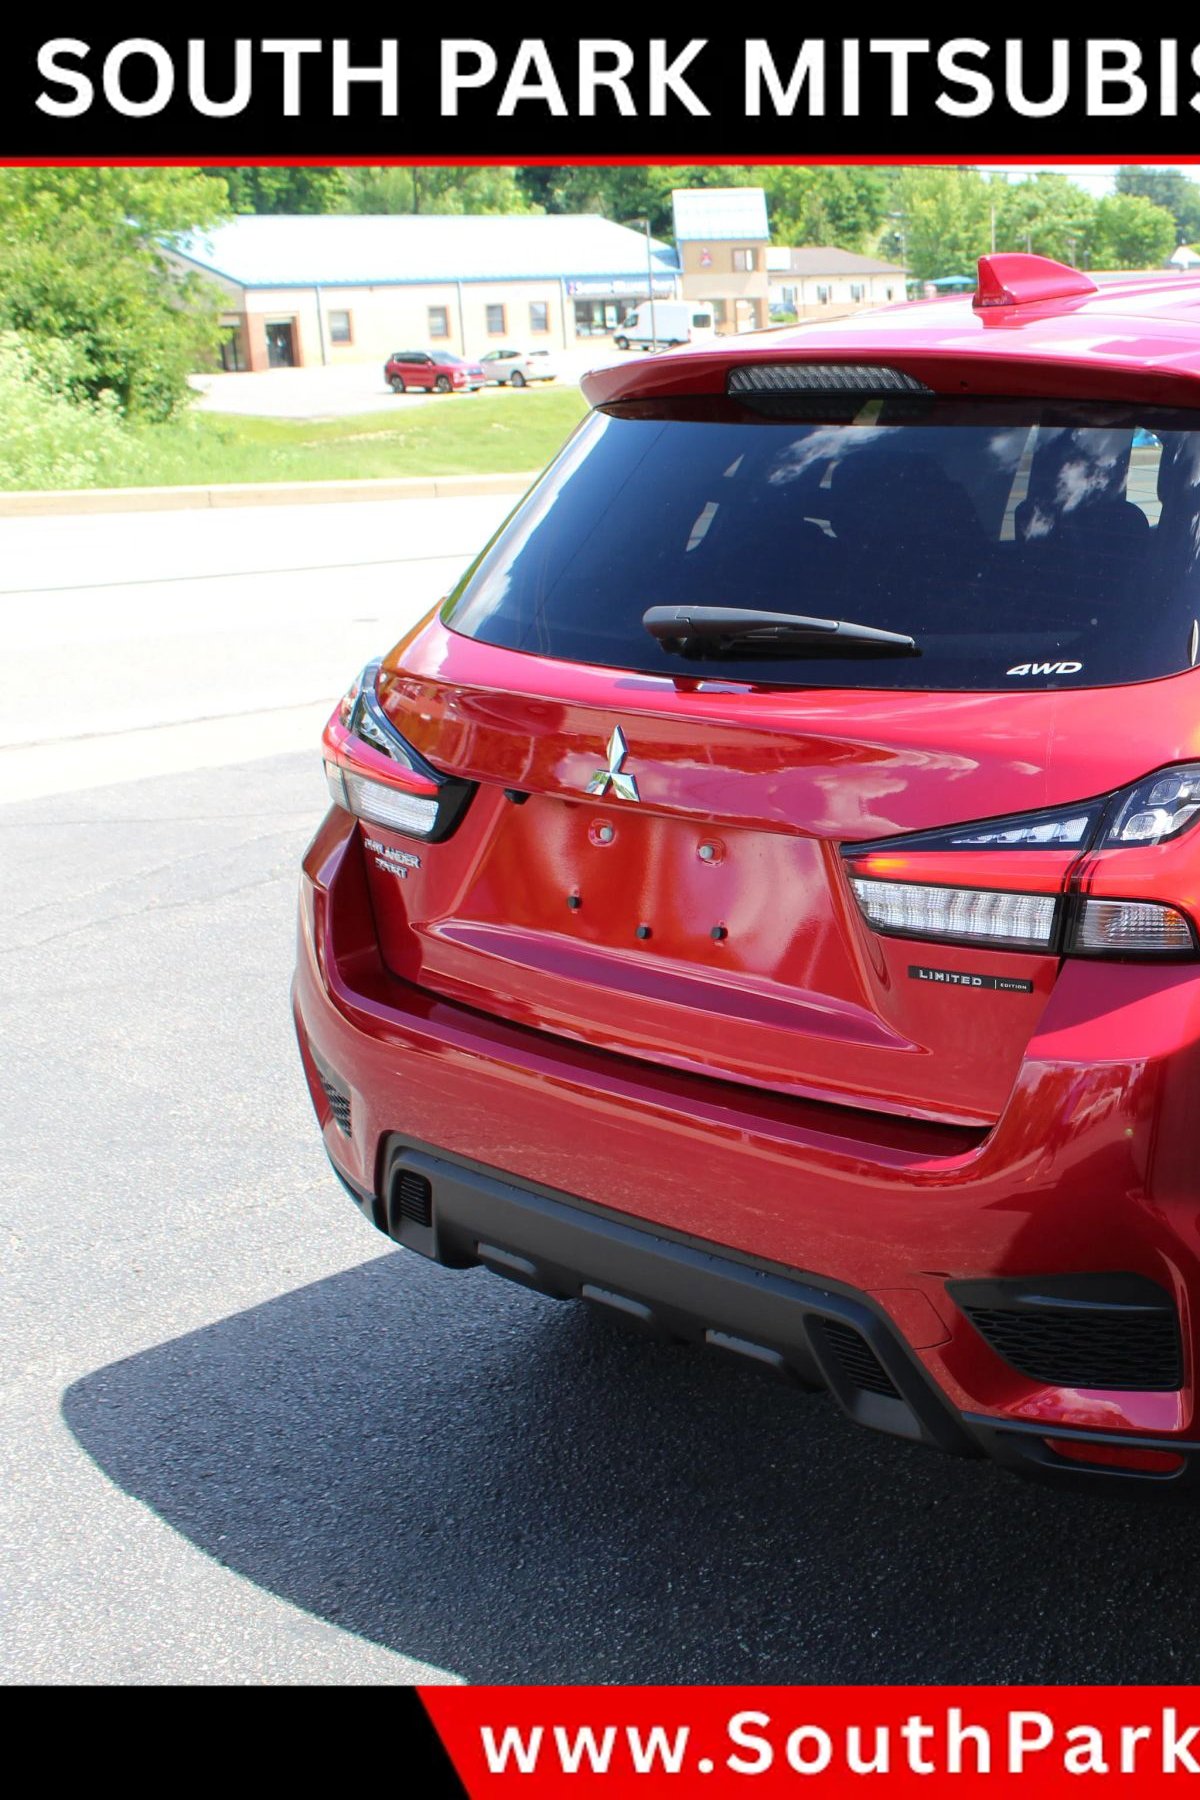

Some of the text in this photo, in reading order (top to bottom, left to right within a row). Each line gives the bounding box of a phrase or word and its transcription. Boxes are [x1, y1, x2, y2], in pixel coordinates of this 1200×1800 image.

[1006, 662, 1082, 675] 4WD
[919, 969, 1027, 990] LIMITED EDITION
